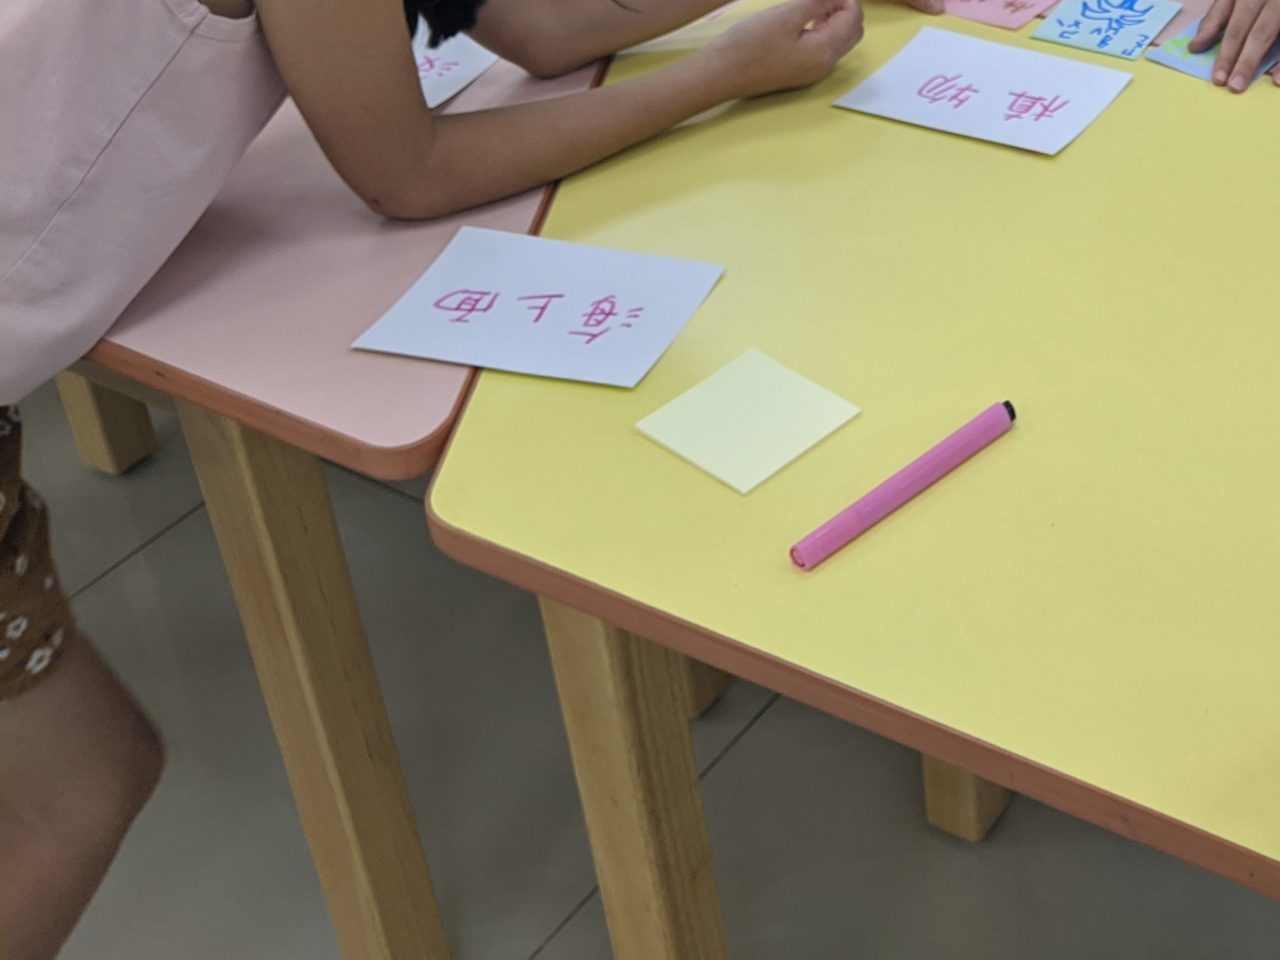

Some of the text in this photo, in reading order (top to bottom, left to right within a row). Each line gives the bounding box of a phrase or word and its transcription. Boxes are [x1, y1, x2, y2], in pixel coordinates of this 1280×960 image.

[916, 74, 1070, 122] 植物
[433, 289, 645, 345] 海上面
